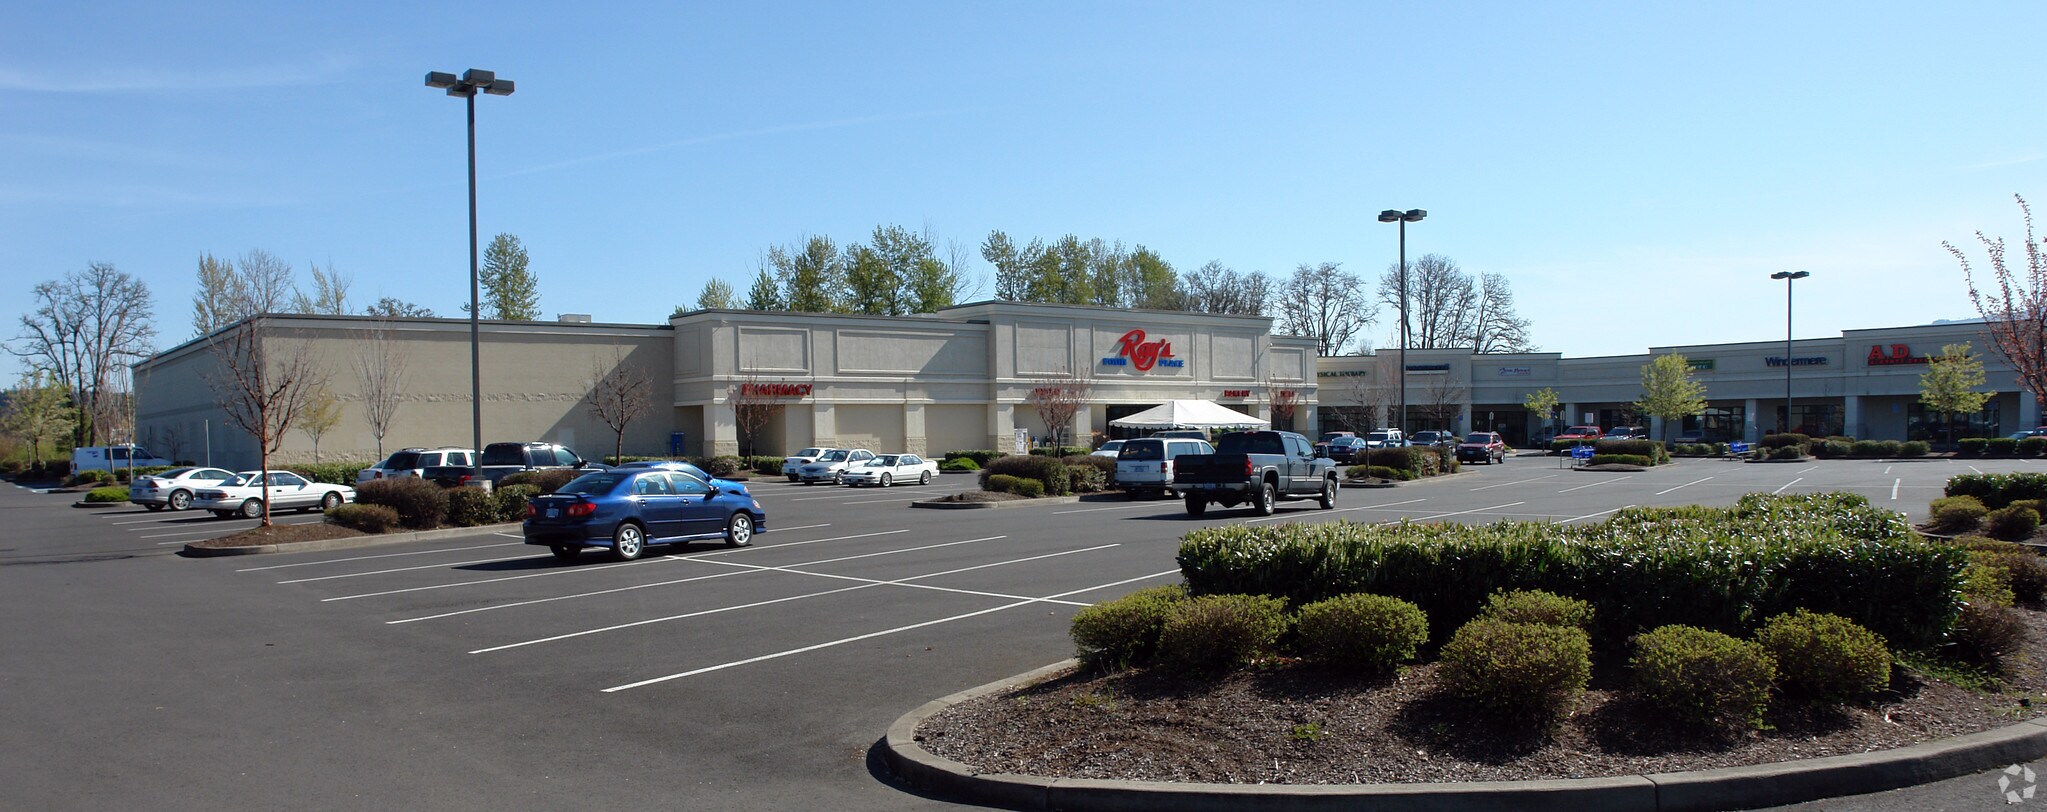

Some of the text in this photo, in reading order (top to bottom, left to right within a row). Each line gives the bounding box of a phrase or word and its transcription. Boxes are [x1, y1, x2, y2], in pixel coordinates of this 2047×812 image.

[1118, 329, 1175, 371] Ray's
[1159, 360, 1184, 368] PLACE
[741, 384, 813, 396] PHARMACY
